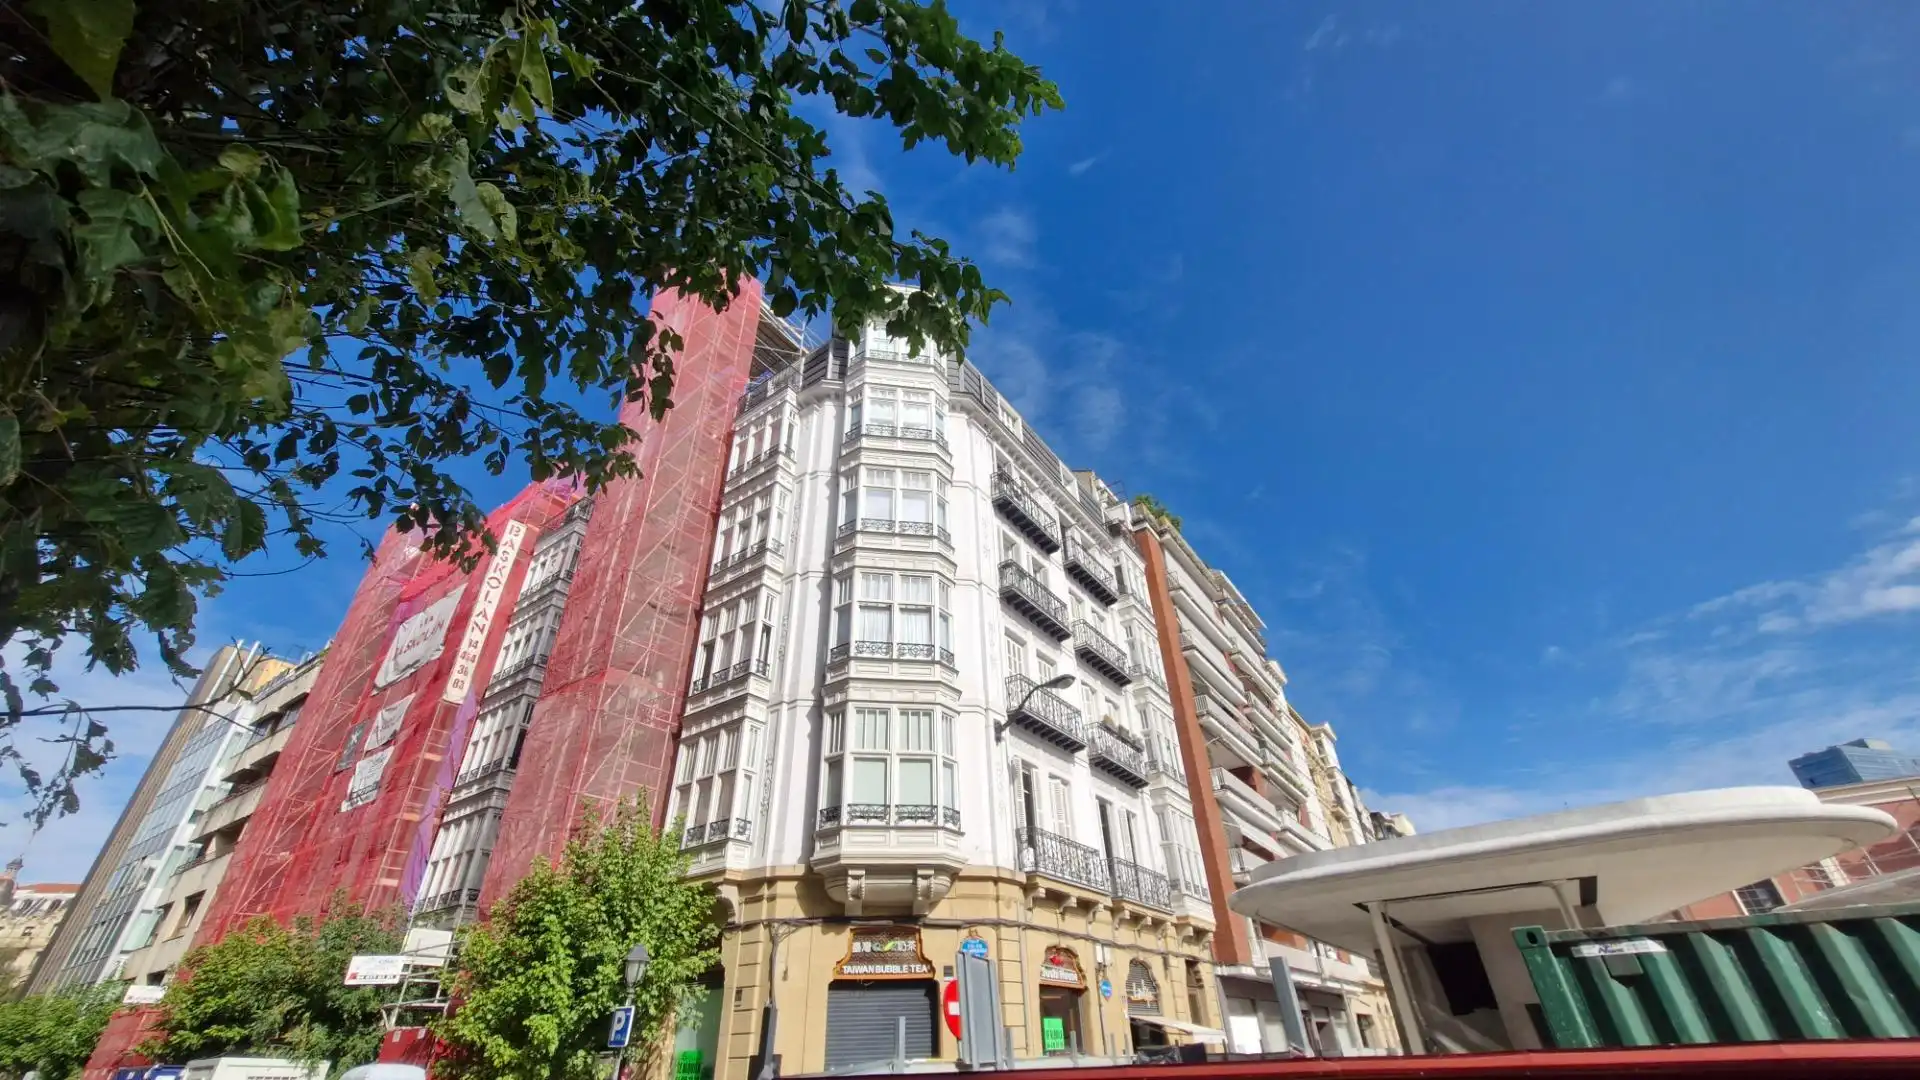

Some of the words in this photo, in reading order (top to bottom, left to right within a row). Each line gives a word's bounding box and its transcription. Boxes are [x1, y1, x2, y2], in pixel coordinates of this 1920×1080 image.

[843, 964, 875, 974] TAIWAN
[876, 964, 908, 974] BUBBLE
[910, 964, 928, 974] TEA
[610, 1010, 626, 1041] P
